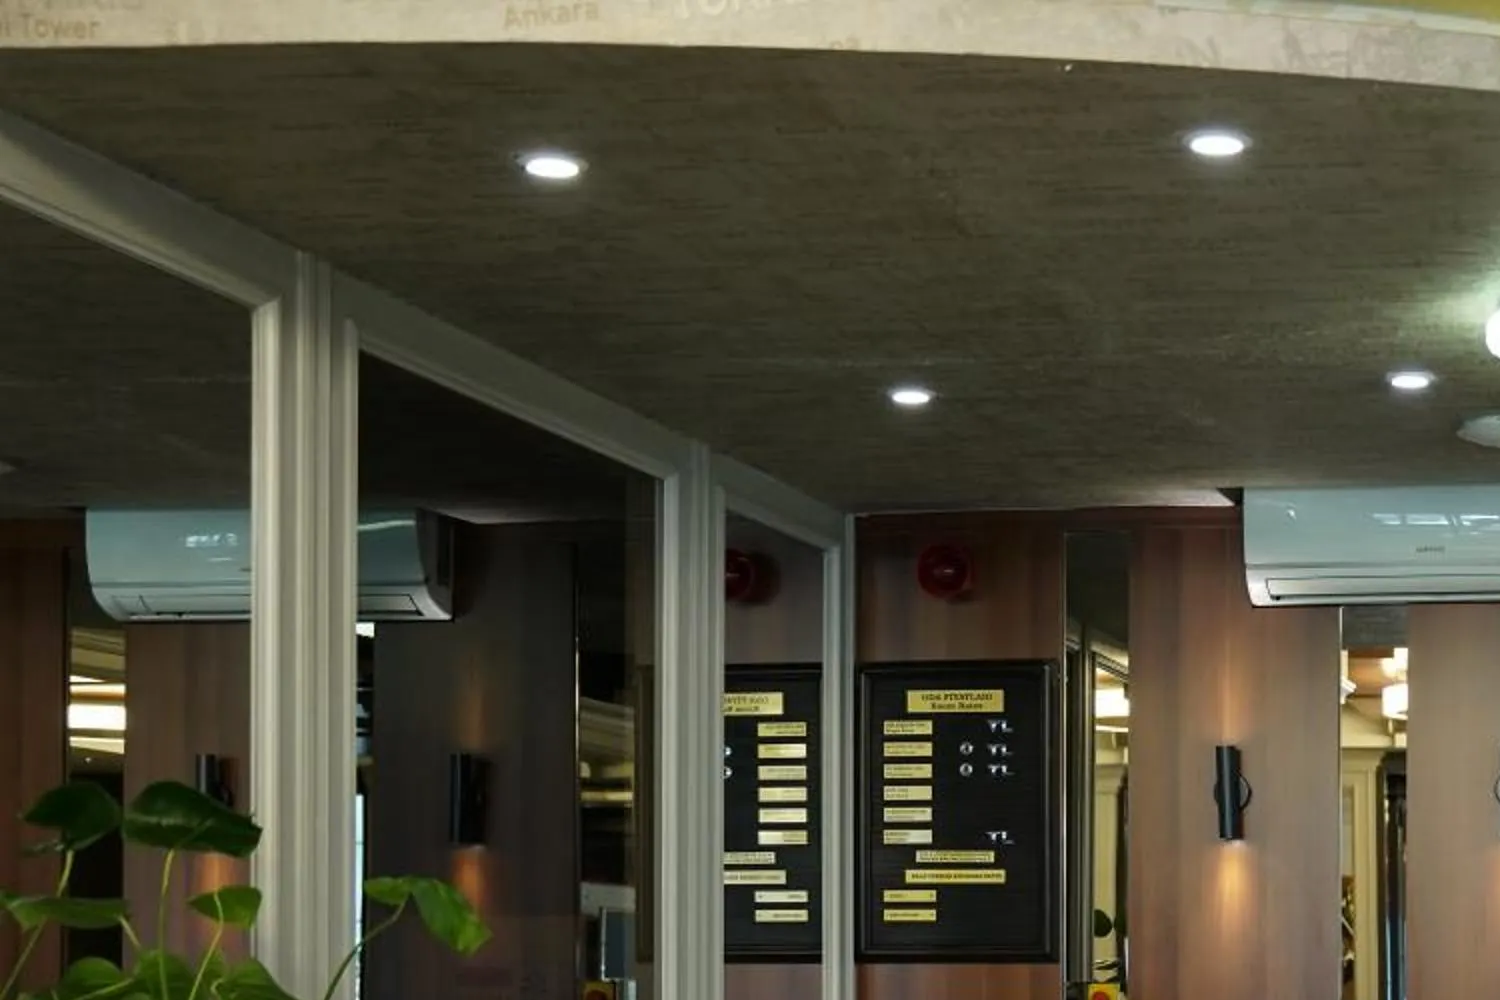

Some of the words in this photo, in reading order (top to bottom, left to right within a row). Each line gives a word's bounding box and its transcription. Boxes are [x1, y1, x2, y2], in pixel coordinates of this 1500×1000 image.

[503, 1, 600, 30] Ankara
[987, 719, 1014, 733] TL
[987, 744, 1014, 756] TL
[987, 764, 1016, 777] TL
[986, 831, 1016, 844] TL
